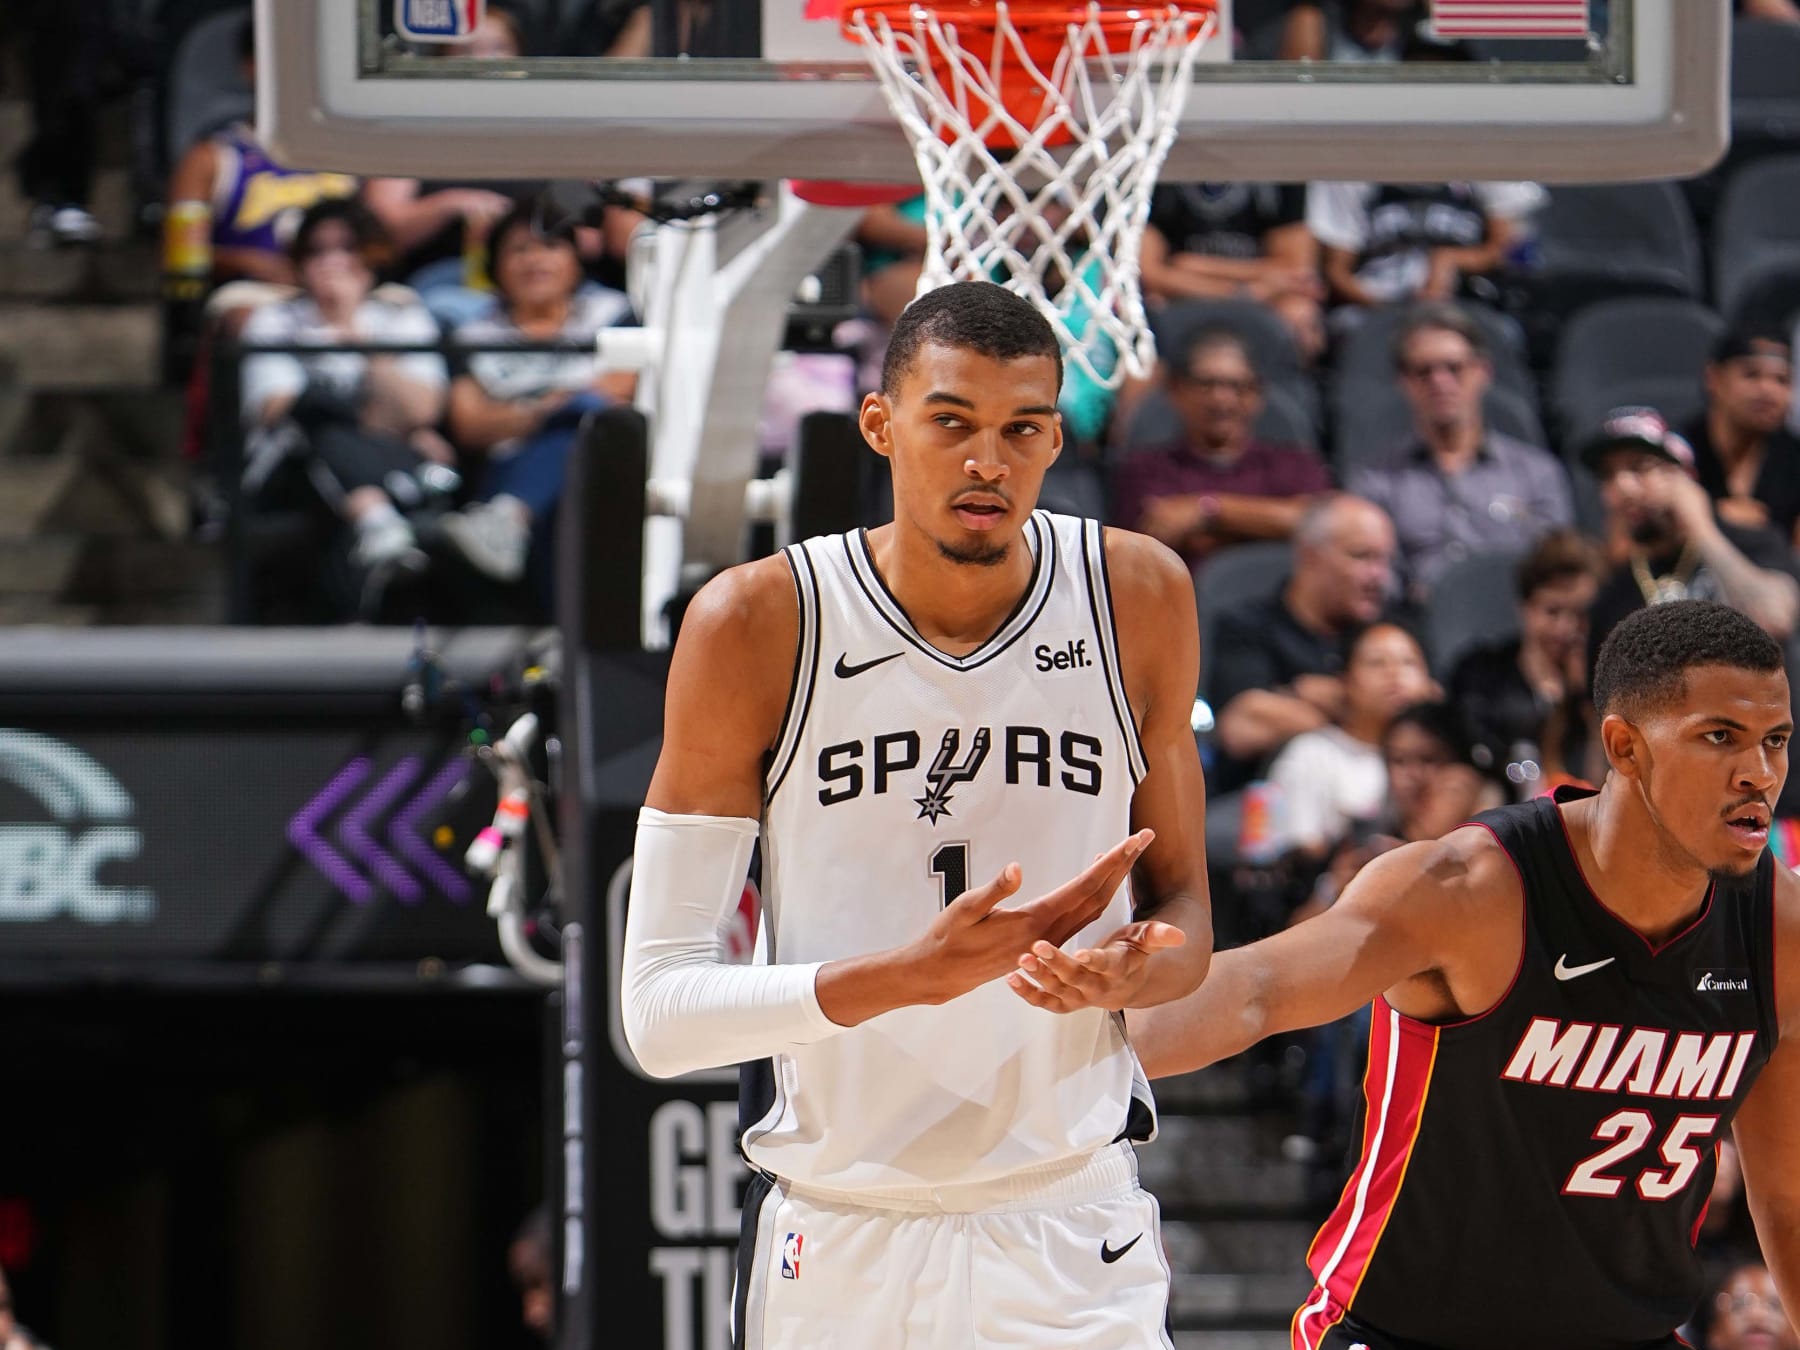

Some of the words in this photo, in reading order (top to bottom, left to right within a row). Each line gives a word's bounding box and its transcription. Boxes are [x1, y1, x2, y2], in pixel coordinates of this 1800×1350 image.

[1035, 639, 1092, 672] Self.
[818, 726, 1103, 826] SPURS
[928, 839, 971, 912] 1
[1707, 978, 1748, 991] Carnival
[1500, 1016, 1757, 1100] MIAMI
[1560, 1107, 1721, 1201] 25
